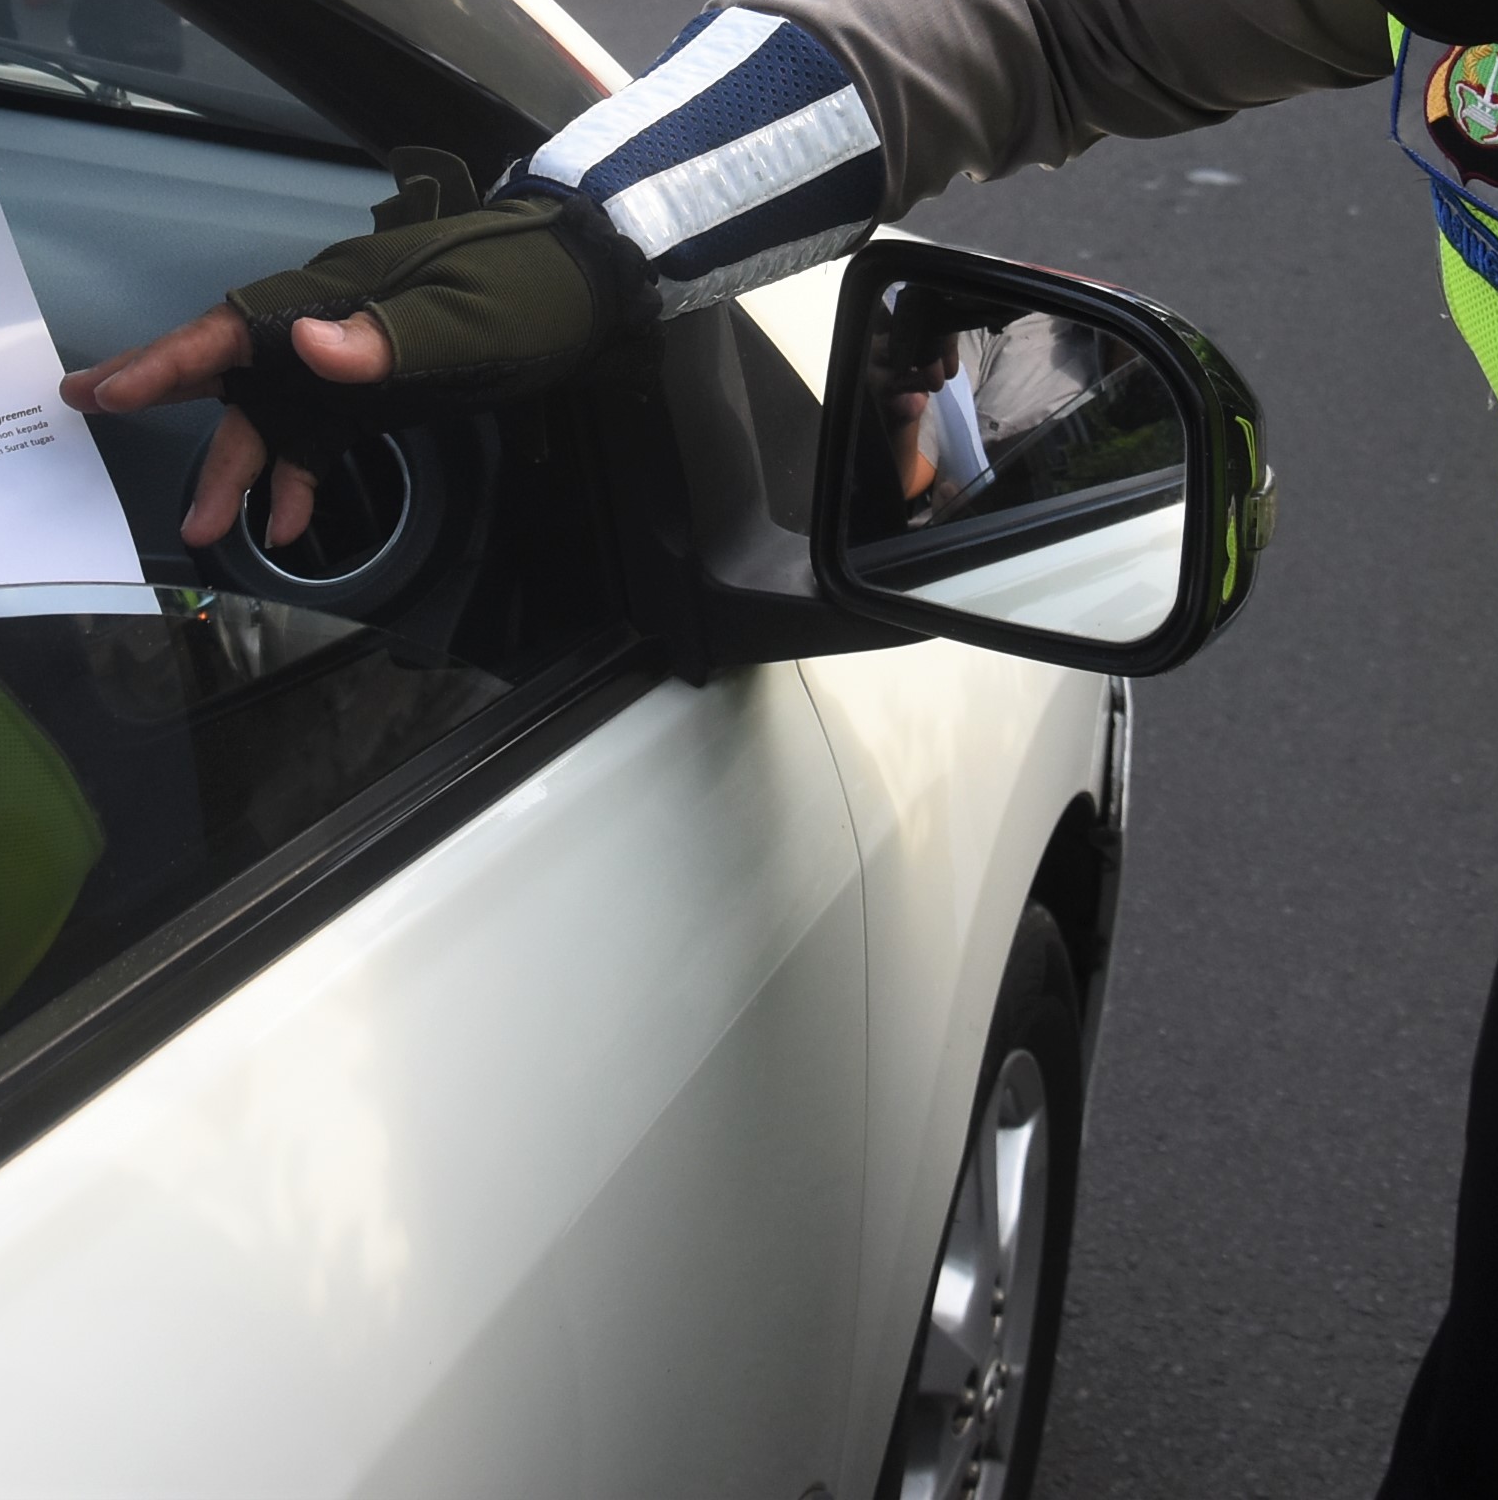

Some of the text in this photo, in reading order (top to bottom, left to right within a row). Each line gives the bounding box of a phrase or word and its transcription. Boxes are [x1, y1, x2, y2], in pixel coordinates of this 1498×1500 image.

[16, 420, 49, 437] kepada
[4, 441, 30, 454] Surat
[31, 433, 55, 449] tugas
